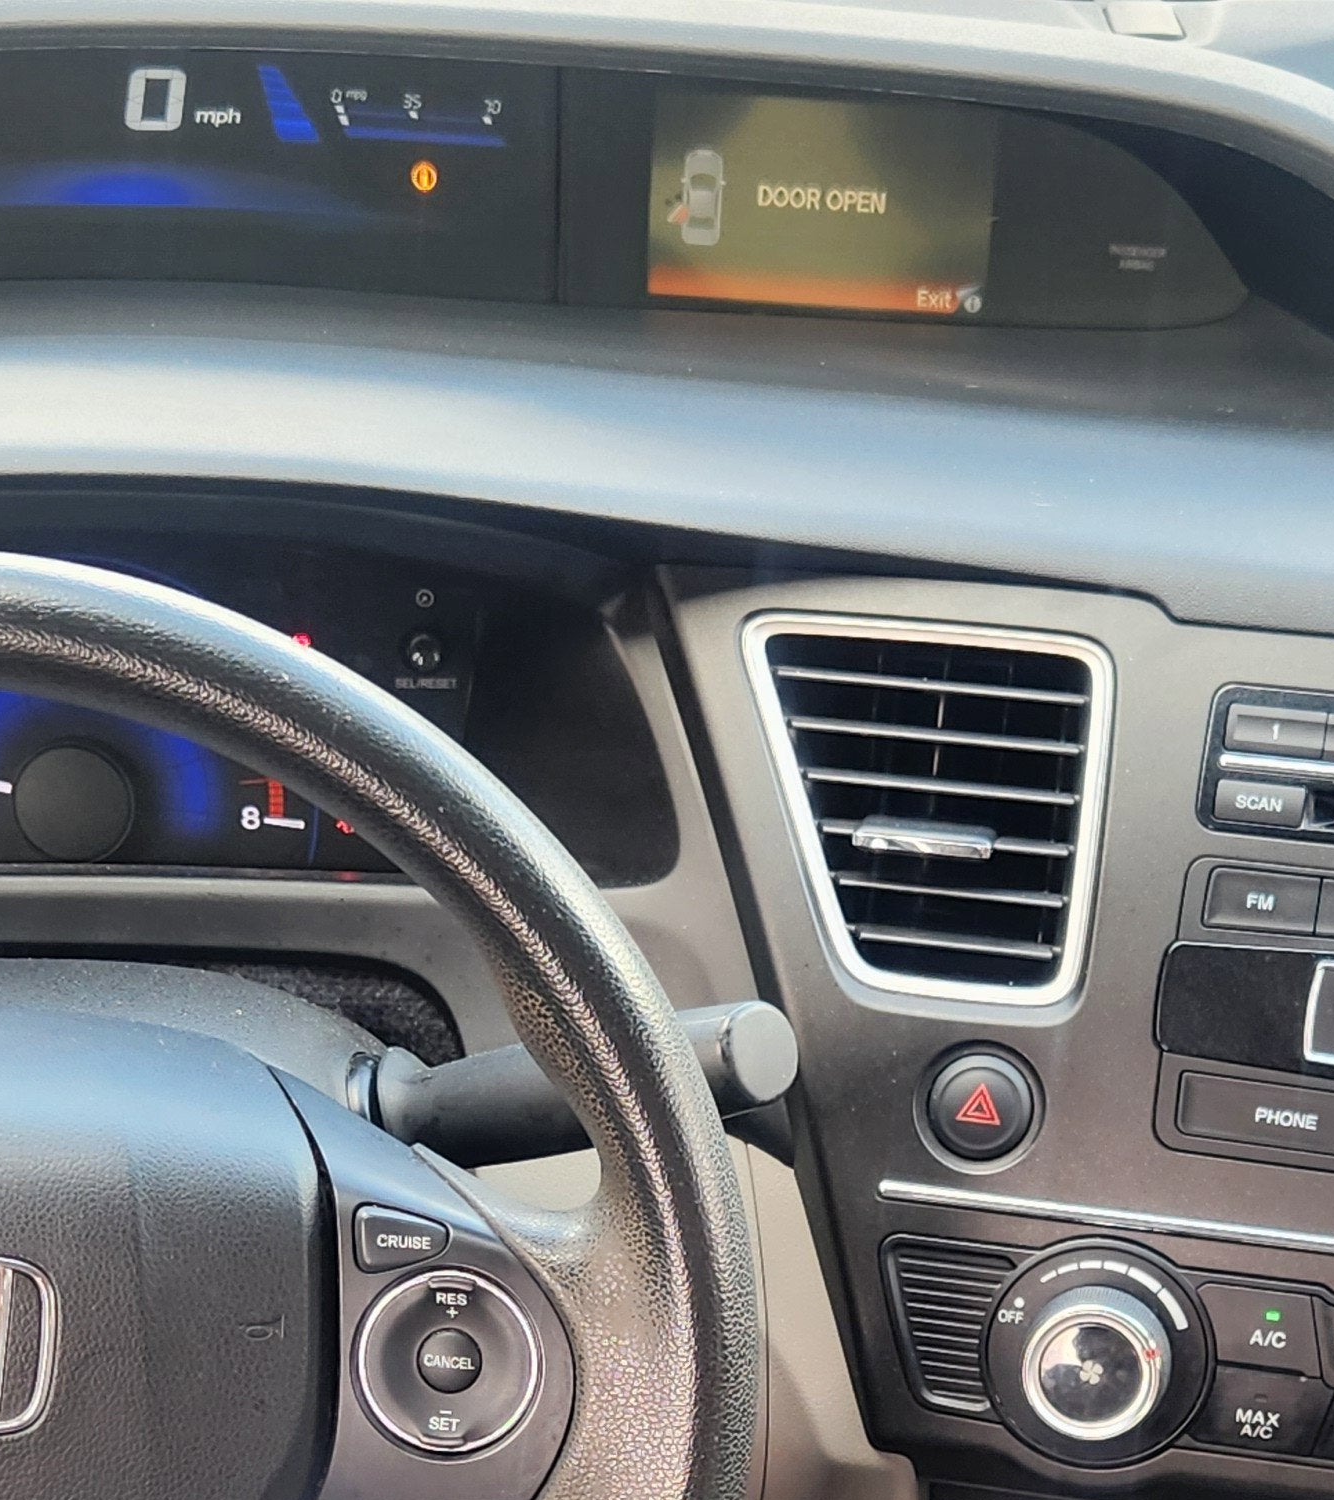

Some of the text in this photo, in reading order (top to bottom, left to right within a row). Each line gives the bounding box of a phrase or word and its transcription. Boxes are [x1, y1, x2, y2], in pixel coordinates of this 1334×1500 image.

[124, 68, 241, 131] 0 mph
[757, 185, 886, 214] DOOR OPEN
[917, 288, 952, 309] Exit
[1271, 723, 1280, 741] 1
[1234, 793, 1283, 813] SCAN
[240, 805, 261, 830] 8
[1246, 891, 1274, 912] FM
[1254, 1107, 1319, 1131] PHONE
[376, 1232, 432, 1251] CRUISE
[435, 1292, 468, 1307] RES
[997, 1309, 1024, 1325] OFF
[1249, 1328, 1287, 1350] A/C
[423, 1353, 476, 1371] CANCEL
[428, 1415, 461, 1432] SET
[1235, 1407, 1280, 1428] MAX
[1239, 1424, 1273, 1441] A/C
